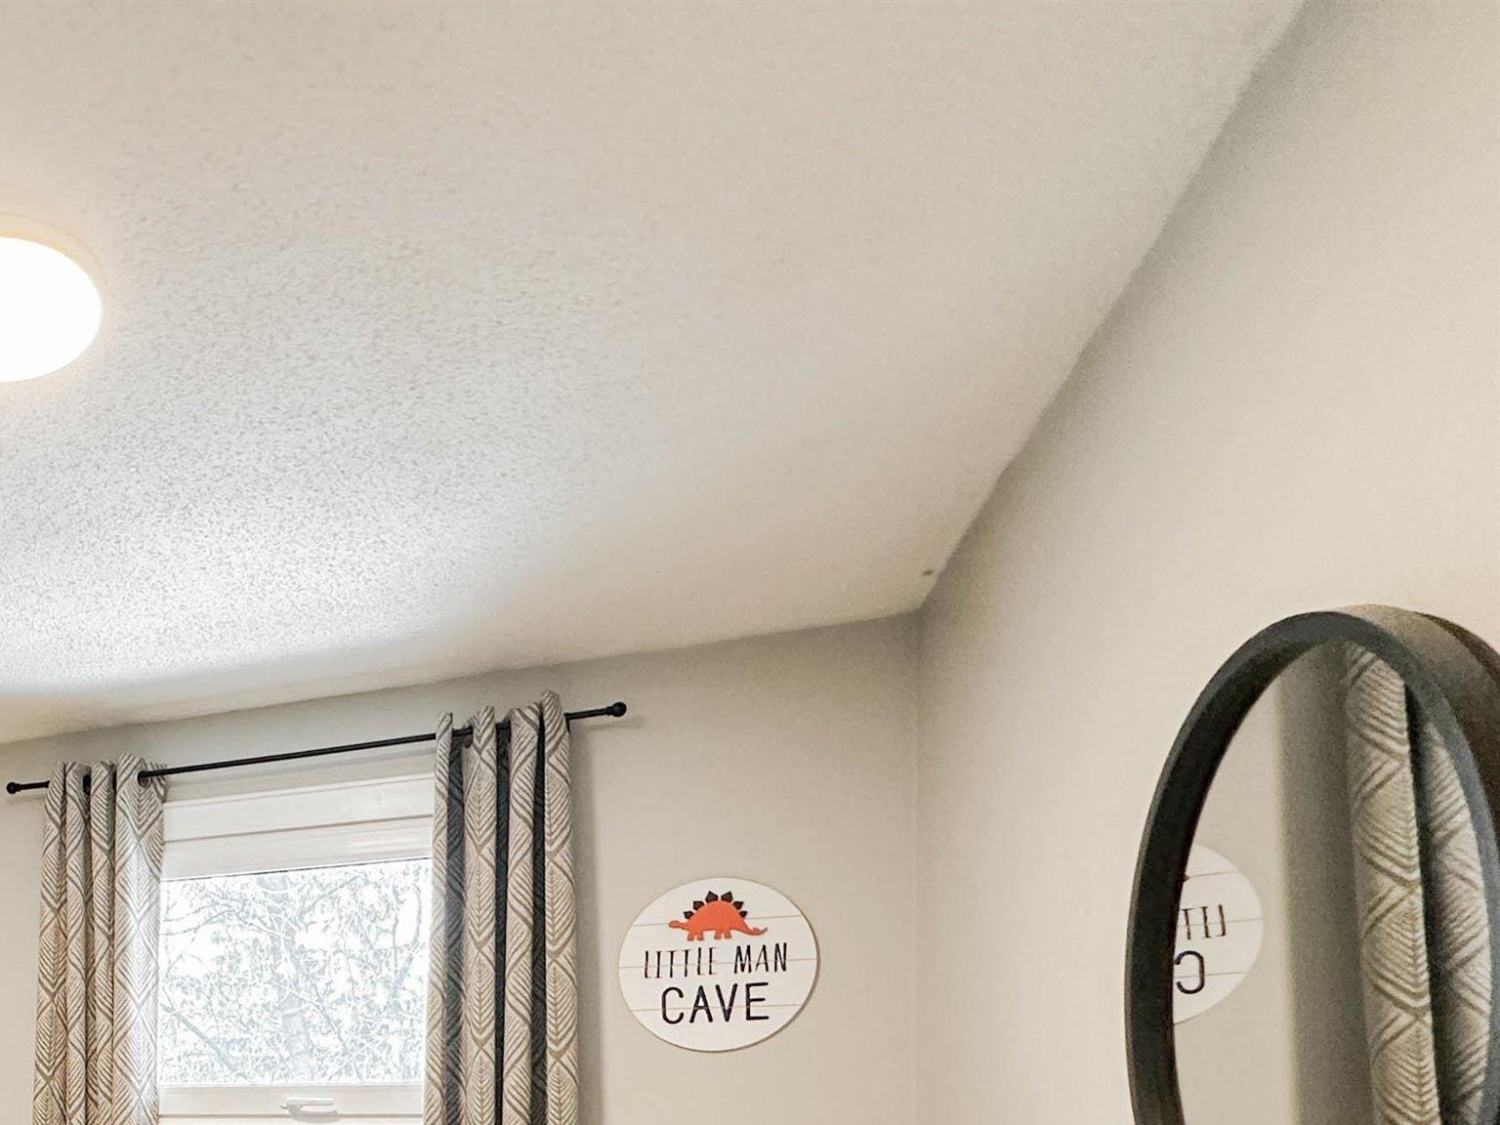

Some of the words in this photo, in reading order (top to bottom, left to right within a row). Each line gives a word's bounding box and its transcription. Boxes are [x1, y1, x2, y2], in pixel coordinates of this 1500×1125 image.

[644, 947, 717, 979] LITTLE
[734, 942, 788, 974] MAN
[661, 982, 770, 1025] CAVE
